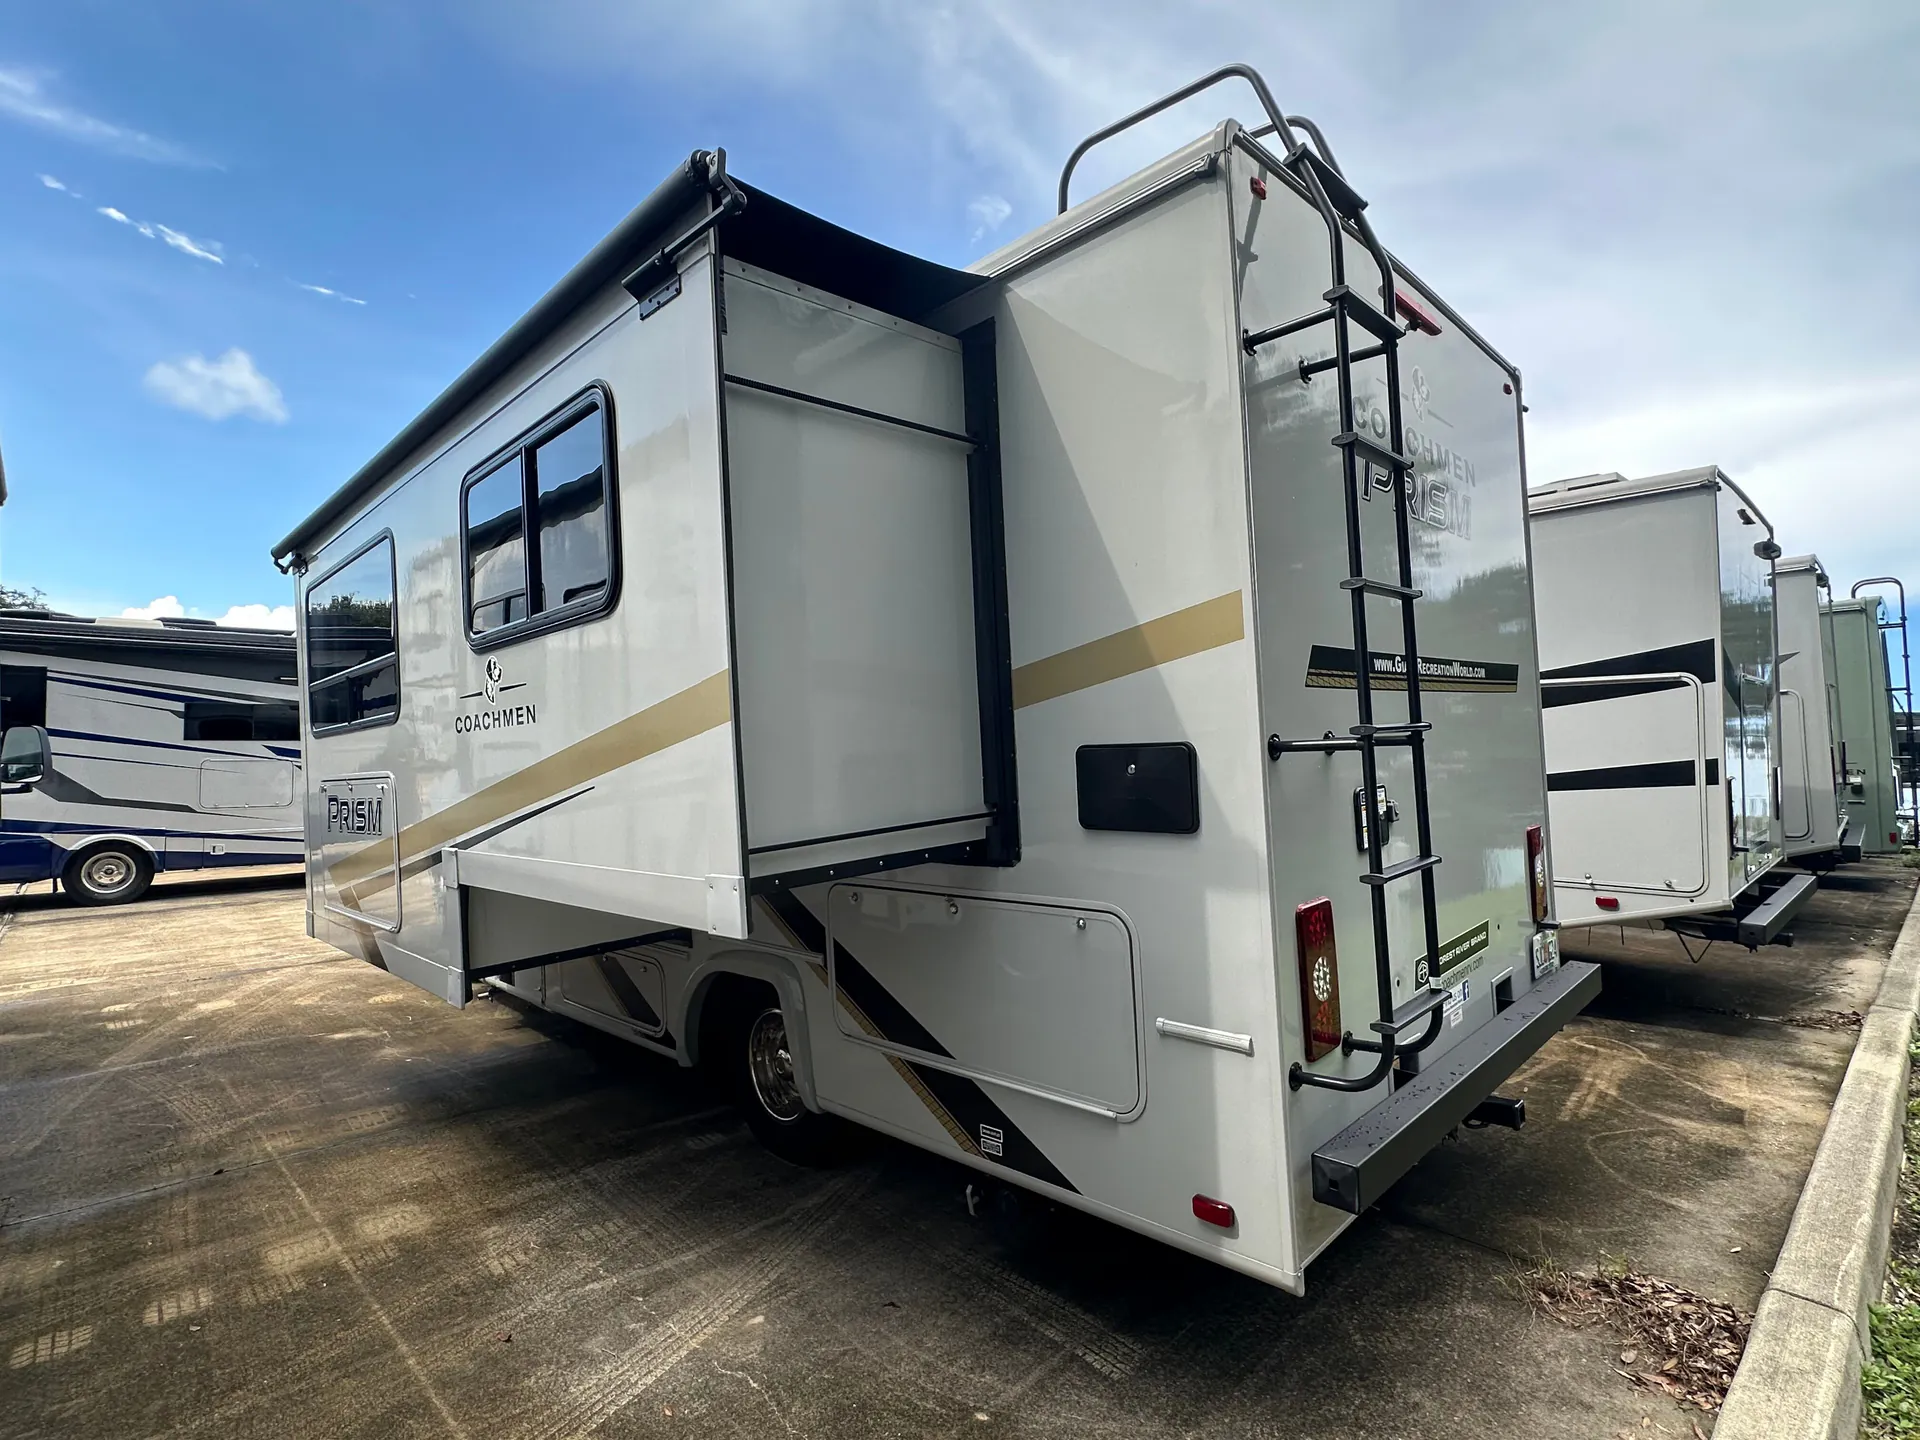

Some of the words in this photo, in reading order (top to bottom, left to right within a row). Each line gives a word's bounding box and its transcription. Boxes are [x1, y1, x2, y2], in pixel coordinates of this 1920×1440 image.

[1352, 396, 1475, 487] COCHMEN
[1373, 655, 1486, 678] WWW.GURECREATIONWORLD.COM
[455, 704, 536, 734] COACHMEN
[327, 794, 382, 835] PRISM
[1438, 948, 1456, 966] OREST
[1455, 940, 1471, 956] RIVER
[1470, 931, 1487, 947] BRAND
